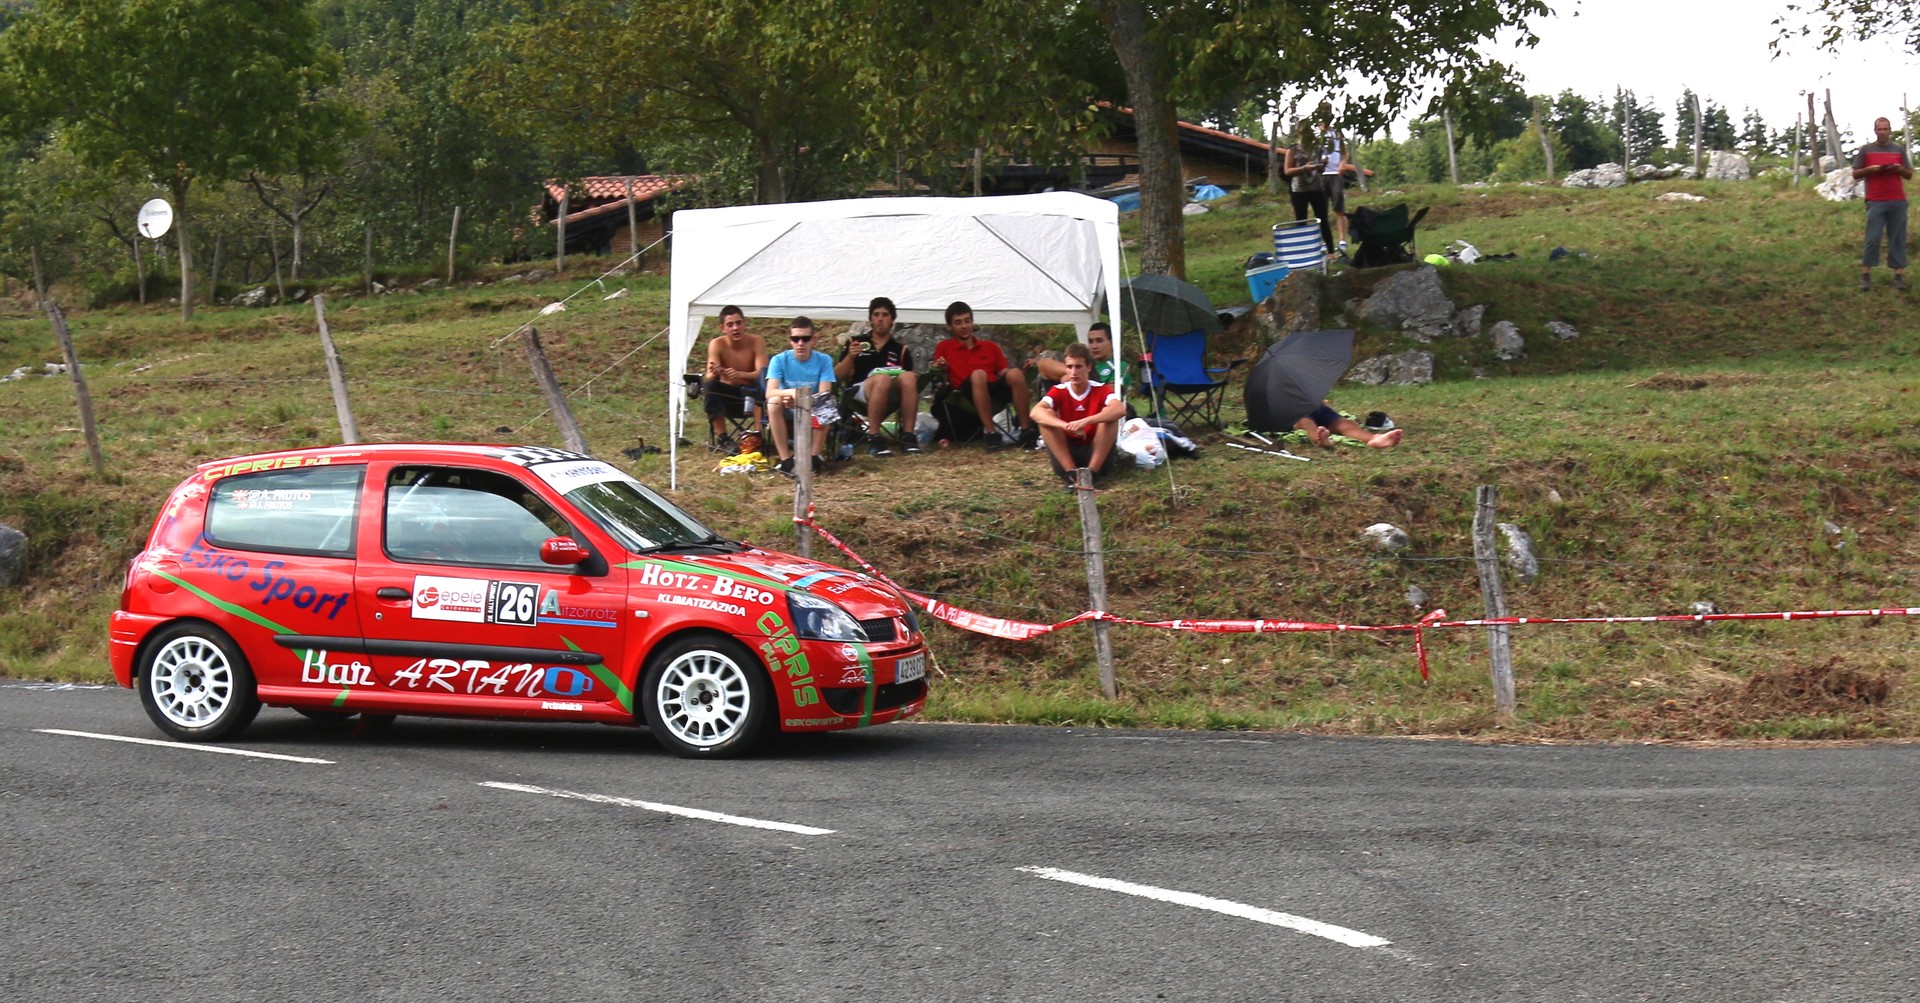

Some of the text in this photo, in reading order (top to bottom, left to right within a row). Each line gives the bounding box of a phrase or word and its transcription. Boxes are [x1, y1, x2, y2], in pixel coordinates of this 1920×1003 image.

[204, 456, 303, 481] CIPRIS
[249, 560, 350, 620] Sport
[441, 590, 482, 604] epele
[499, 585, 534, 621] 26
[657, 593, 746, 617] KLIMATIZAZIOA
[301, 648, 375, 686] Bar
[756, 611, 819, 707] CIPRIS
[759, 642, 782, 672] PUB
